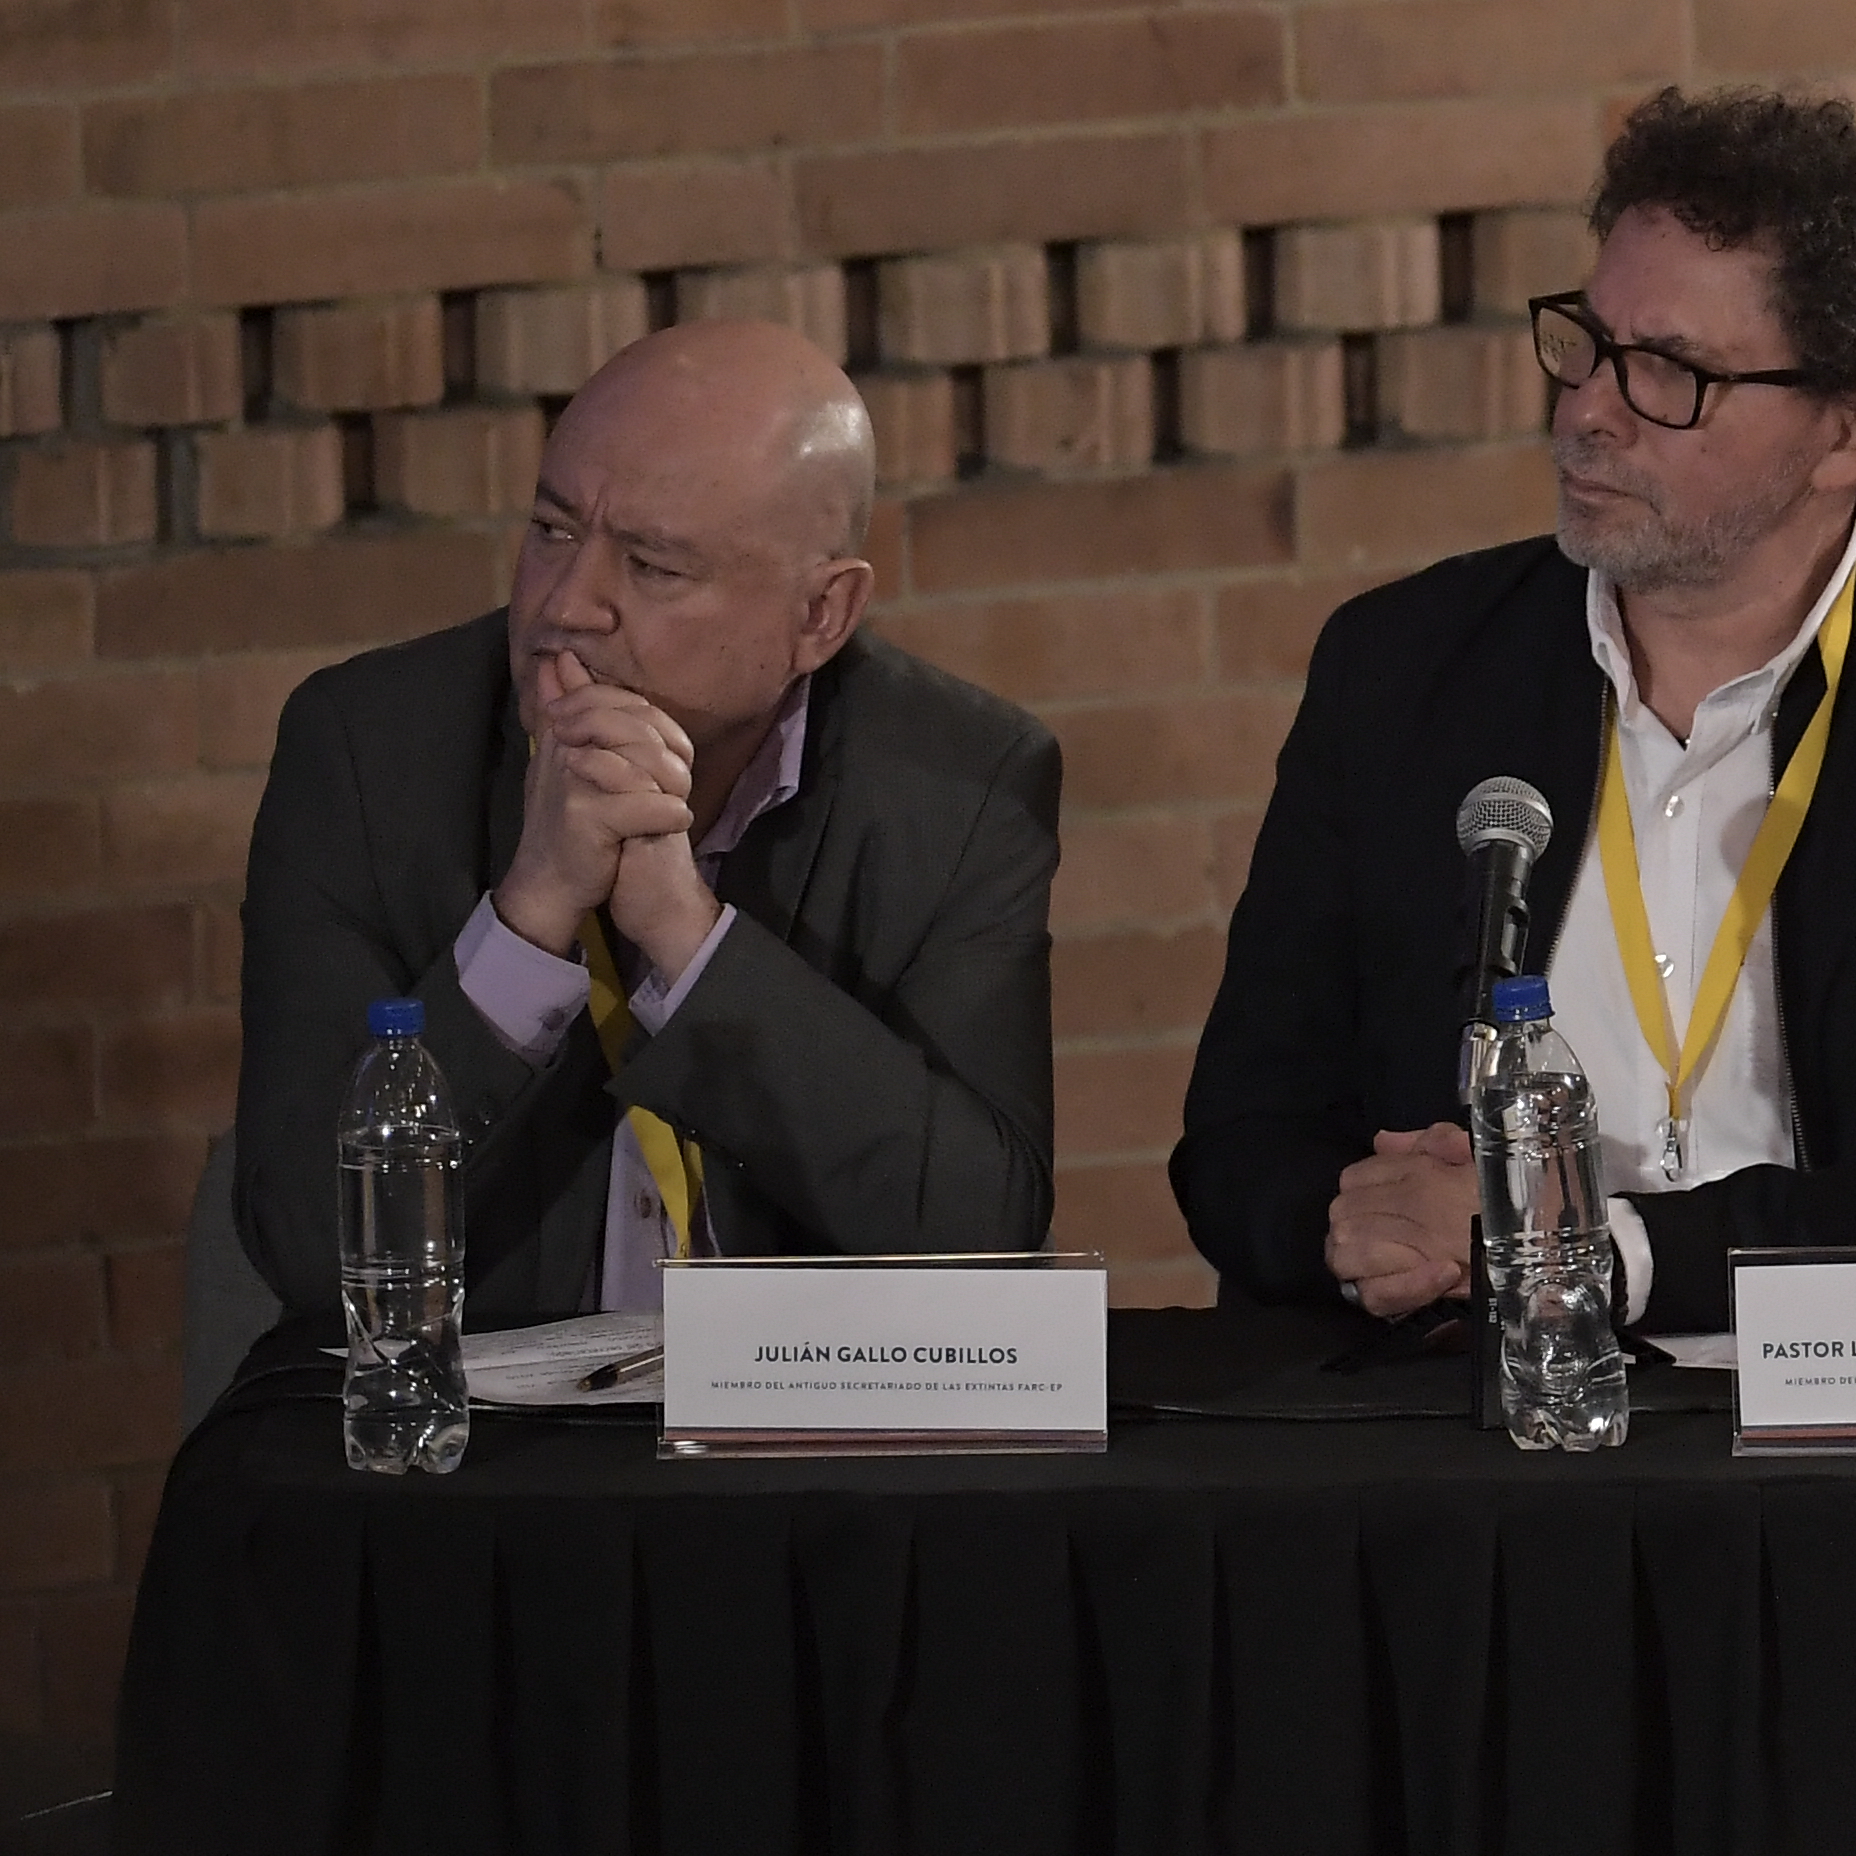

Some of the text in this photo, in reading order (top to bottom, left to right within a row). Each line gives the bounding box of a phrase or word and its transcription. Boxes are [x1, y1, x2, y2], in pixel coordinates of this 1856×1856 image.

[754, 1341, 1018, 1365] JULIÁN GALLO CUBILLOS
[1762, 1341, 1845, 1360] PASTOR
[1784, 1376, 1836, 1386] MIEMBRO
